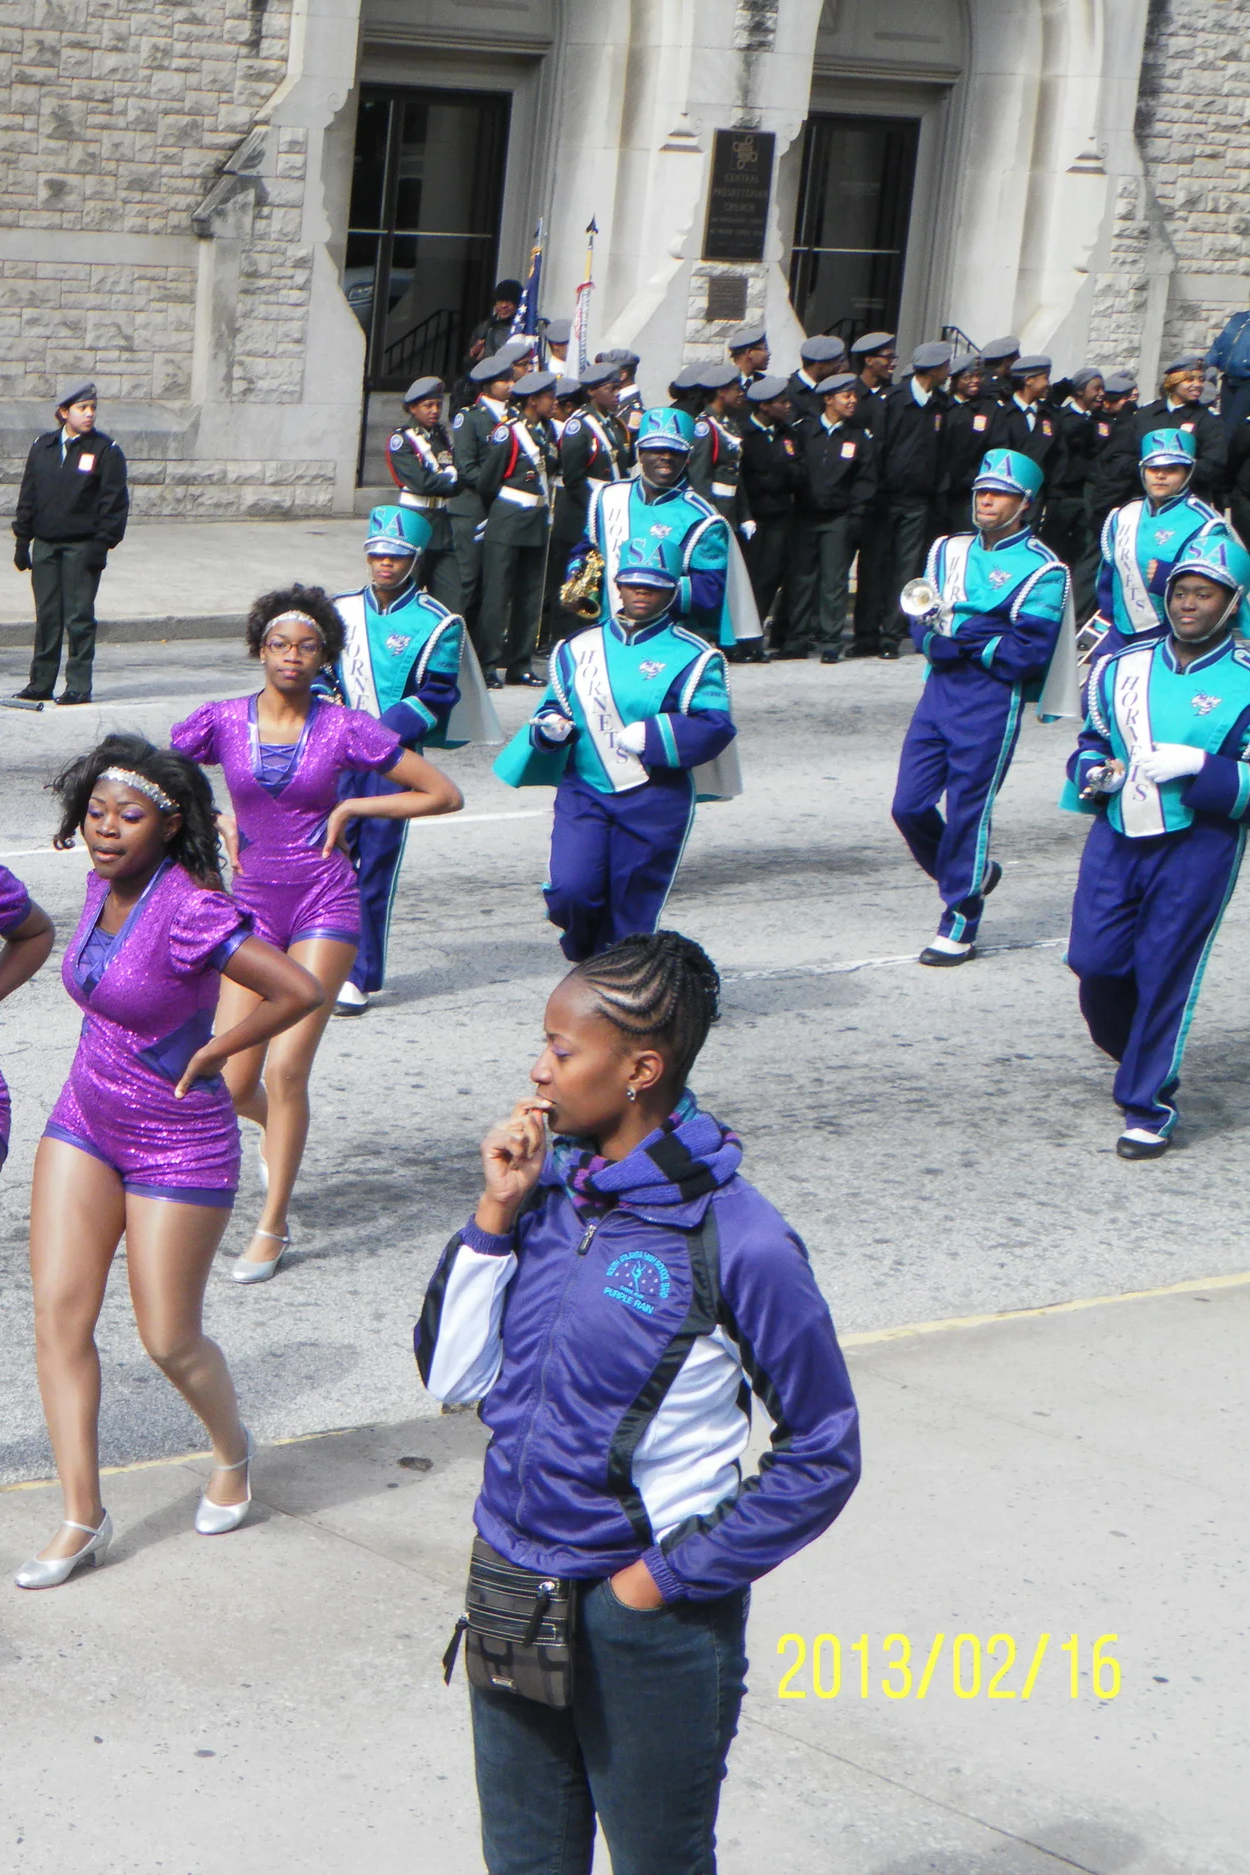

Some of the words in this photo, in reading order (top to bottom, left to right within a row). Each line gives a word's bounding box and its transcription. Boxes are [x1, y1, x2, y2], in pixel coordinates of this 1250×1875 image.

[647, 410, 684, 436] SA
[1151, 432, 1185, 452] SA
[982, 452, 1016, 478] SA
[370, 507, 407, 538] SA
[627, 538, 670, 570] SA
[1186, 537, 1231, 568] SA
[579, 650, 630, 764] HORNETS
[1119, 675, 1149, 802] HORNETS
[603, 1287, 634, 1305] PURPLE
[634, 1300, 655, 1315] RAIN
